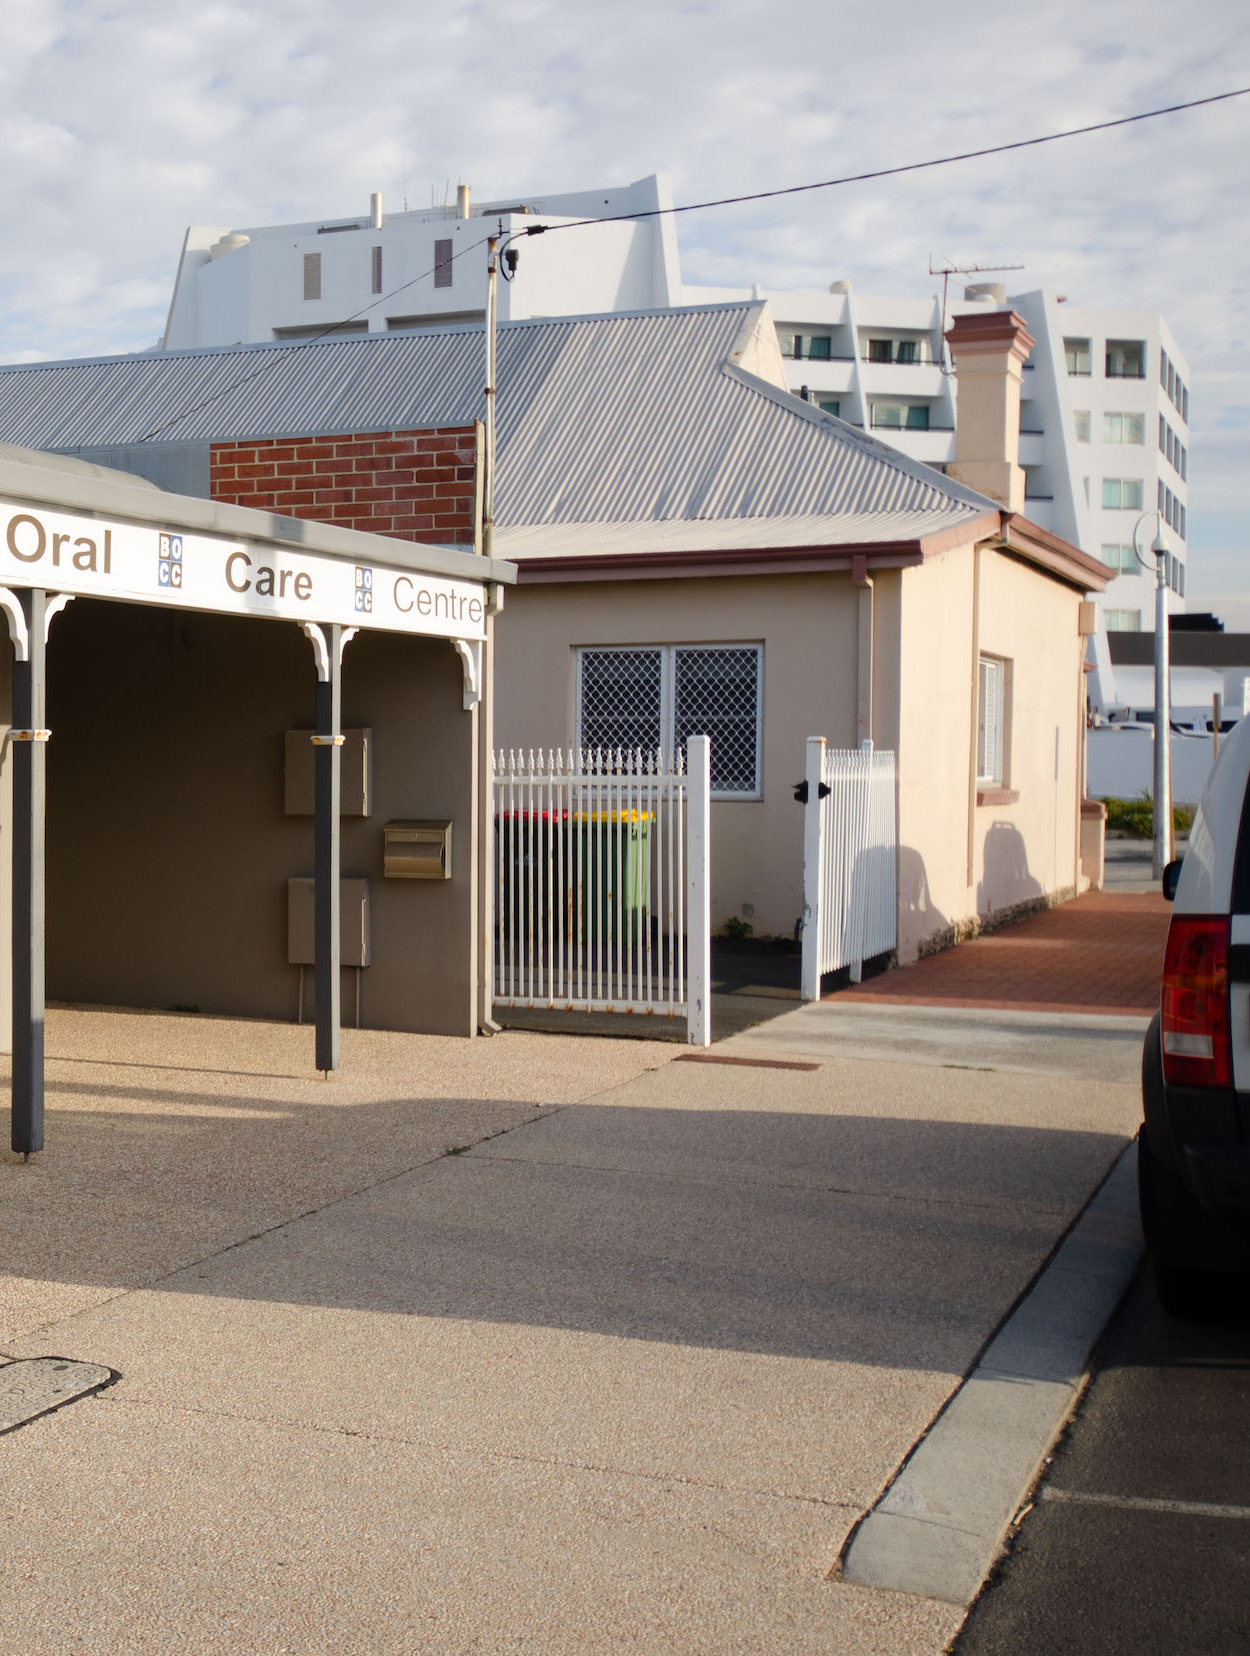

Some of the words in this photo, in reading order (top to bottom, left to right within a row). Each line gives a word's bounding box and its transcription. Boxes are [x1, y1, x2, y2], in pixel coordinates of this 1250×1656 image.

[6, 514, 112, 574] Oral
[225, 552, 313, 601] Care
[393, 576, 482, 623] Centre
